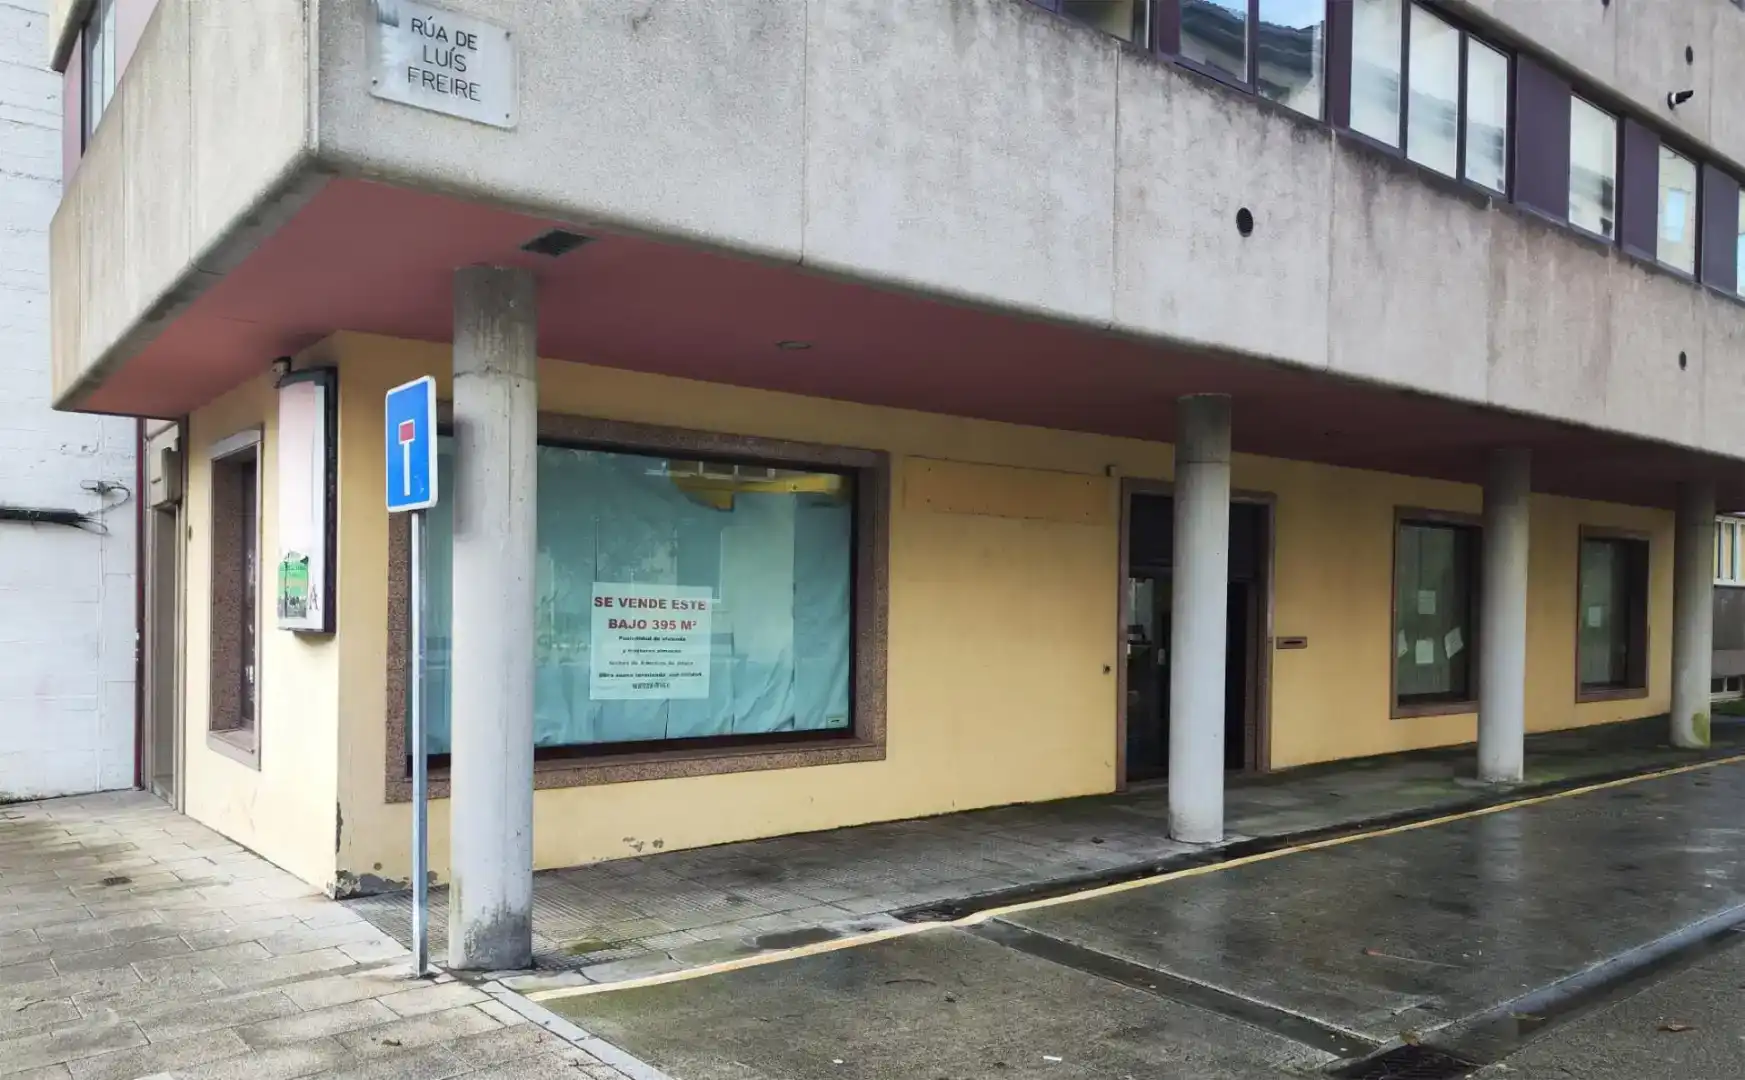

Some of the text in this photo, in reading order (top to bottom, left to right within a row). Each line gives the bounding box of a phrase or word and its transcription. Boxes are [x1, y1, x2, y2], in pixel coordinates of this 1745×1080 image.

[411, 16, 478, 51] RÚA DE
[423, 45, 467, 72] LUÍS
[408, 66, 481, 102] FREIRE
[594, 597, 706, 611] SE VENDE ESTE
[608, 618, 647, 630] BAJO
[652, 619, 677, 631] 395
